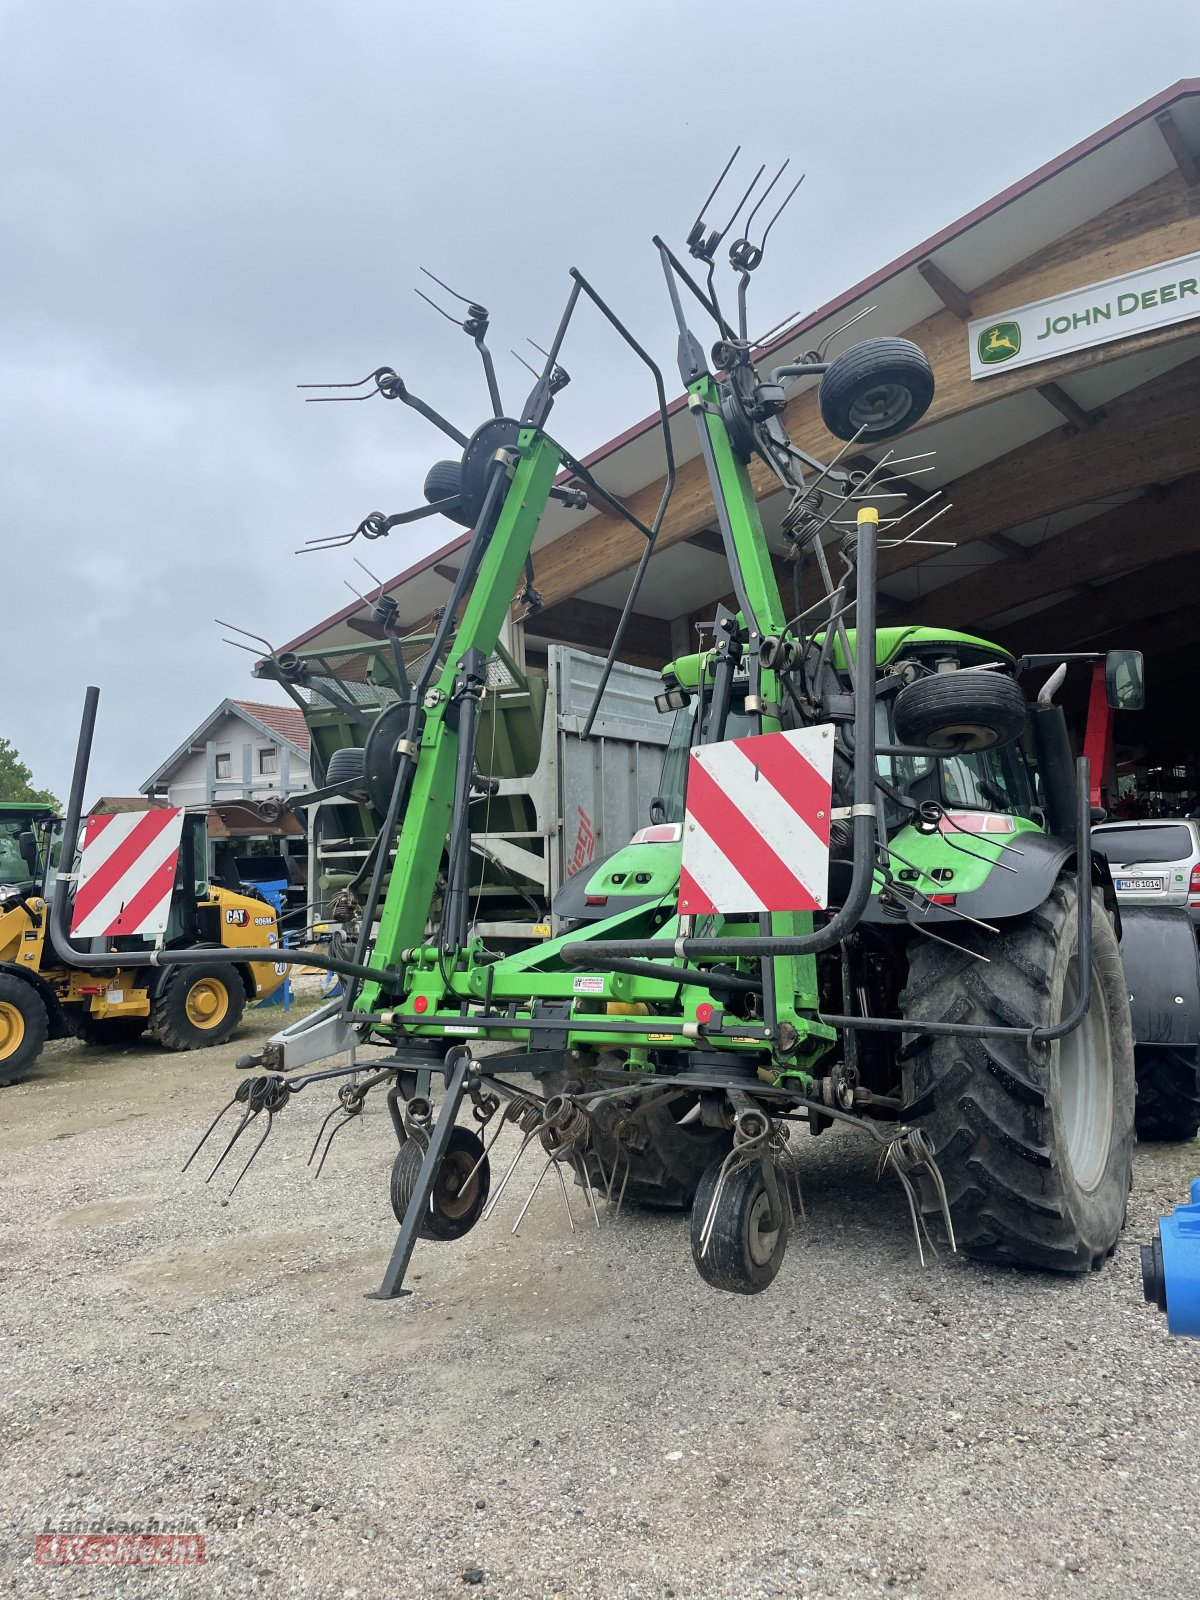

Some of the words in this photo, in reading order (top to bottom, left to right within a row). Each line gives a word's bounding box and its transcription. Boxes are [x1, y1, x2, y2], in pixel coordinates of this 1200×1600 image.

[1037, 302, 1111, 340] JOHN
[1117, 278, 1200, 316] DEER
[226, 909, 245, 924] CAT
[254, 917, 272, 926] 906M
